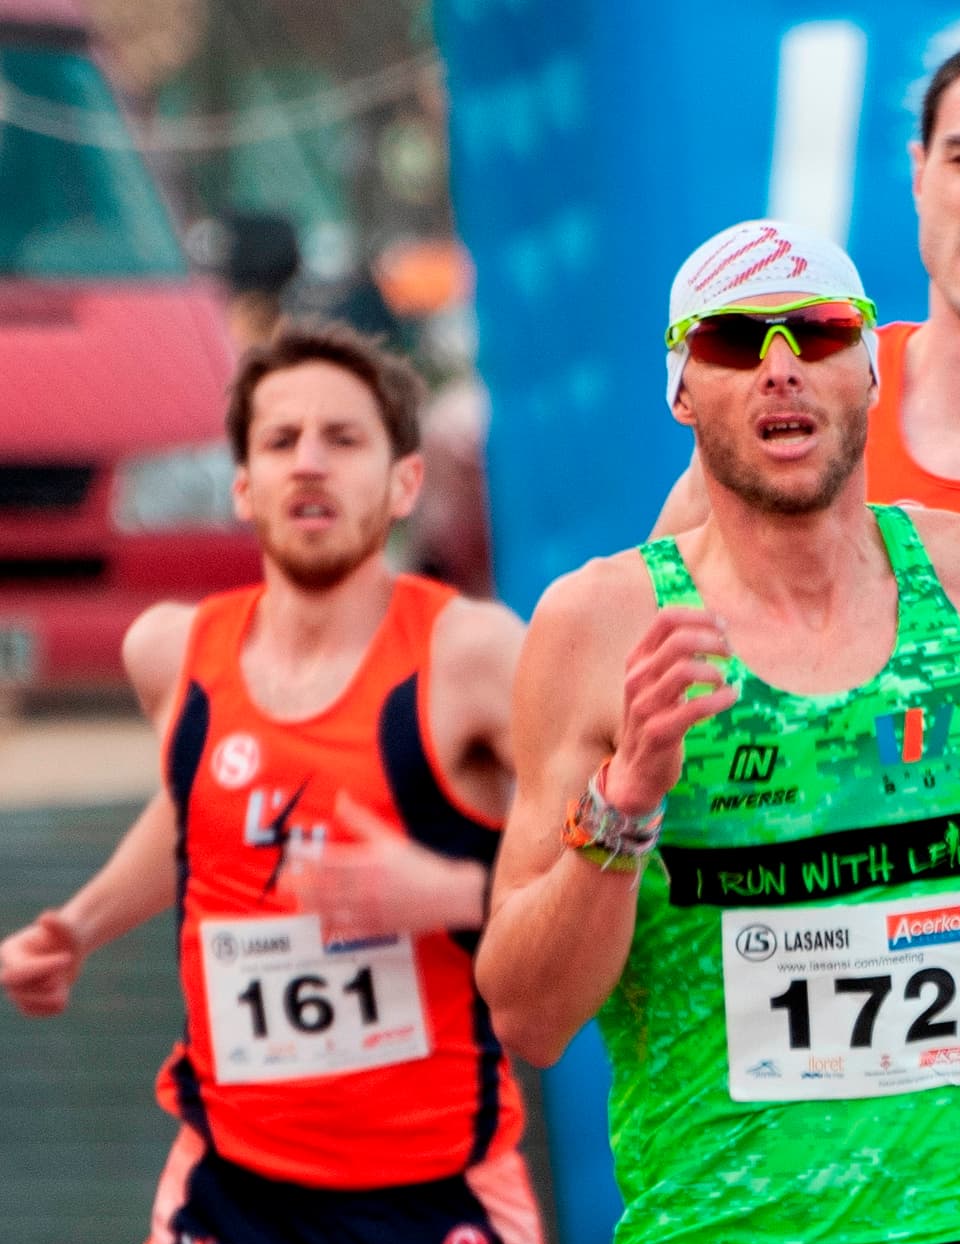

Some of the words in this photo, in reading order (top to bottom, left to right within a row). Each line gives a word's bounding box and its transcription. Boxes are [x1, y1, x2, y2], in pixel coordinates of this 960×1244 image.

[711, 785, 798, 811] INVERSE
[696, 869, 702, 899] I
[719, 863, 786, 896] RUN
[802, 843, 894, 893] WITH
[783, 927, 850, 953] LASANSI
[237, 966, 379, 1040] 161
[769, 967, 959, 1051] 172
